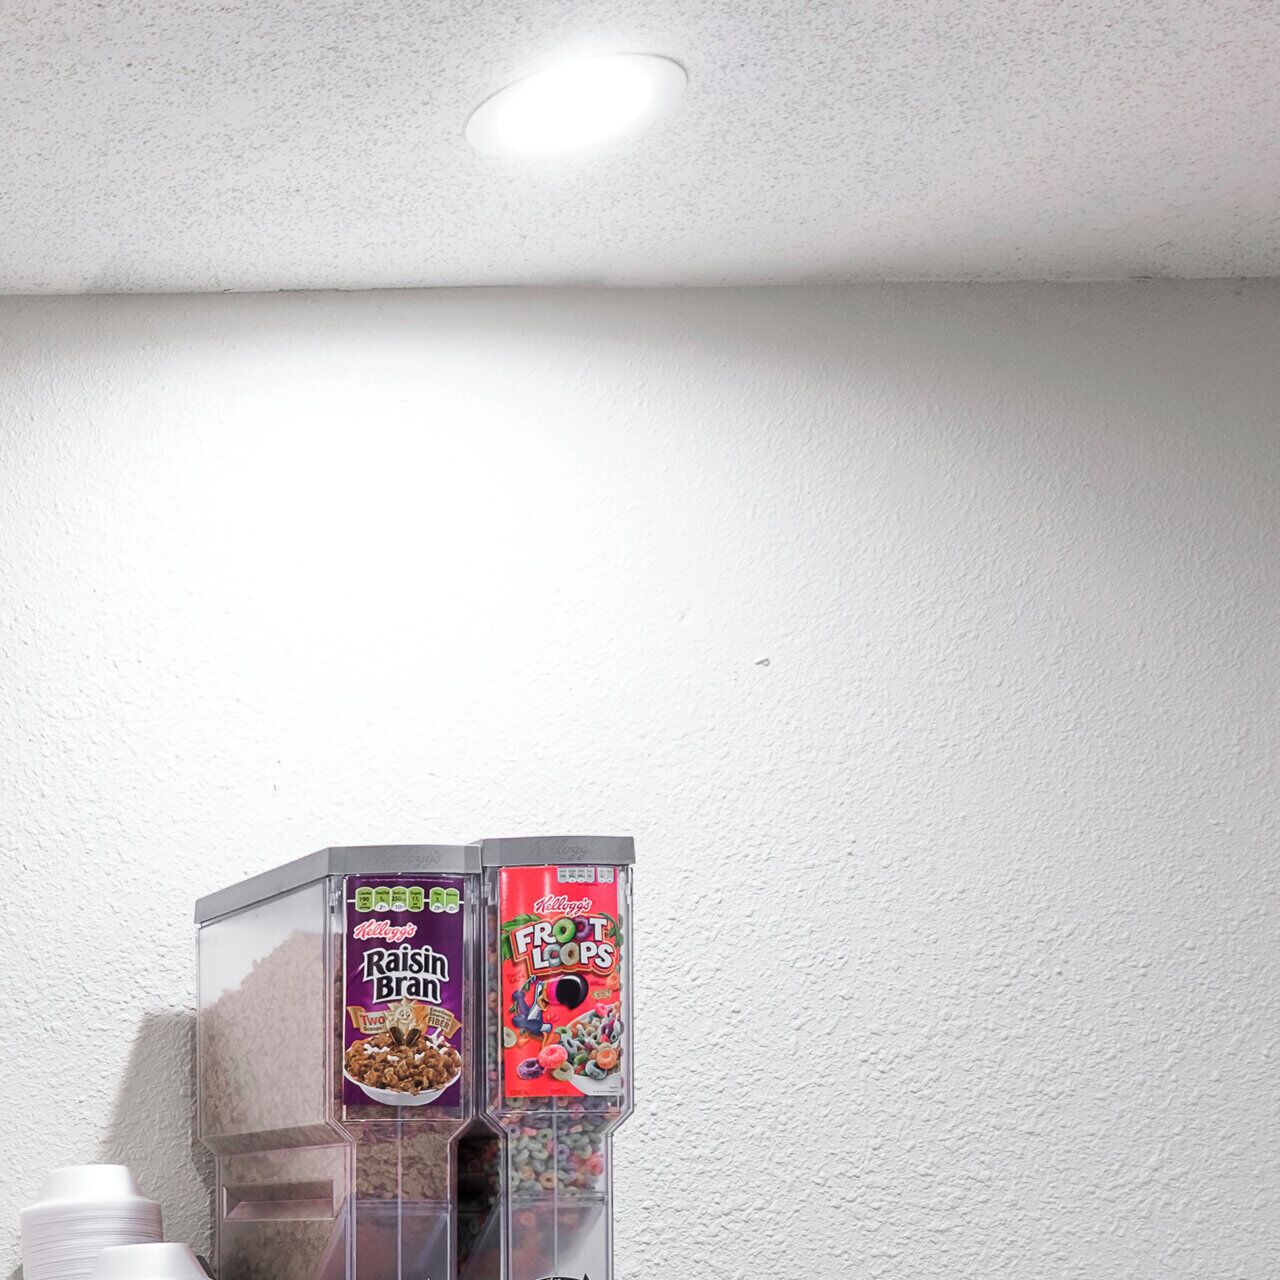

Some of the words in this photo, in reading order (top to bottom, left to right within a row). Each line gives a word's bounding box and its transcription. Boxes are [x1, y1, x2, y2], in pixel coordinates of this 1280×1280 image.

[534, 895, 592, 918] Kellogg's
[354, 919, 417, 942] Kellogg's
[515, 917, 608, 954] FROOT
[364, 945, 448, 980] Raisin
[532, 941, 615, 969] LOOPS
[375, 975, 440, 1002] Bran
